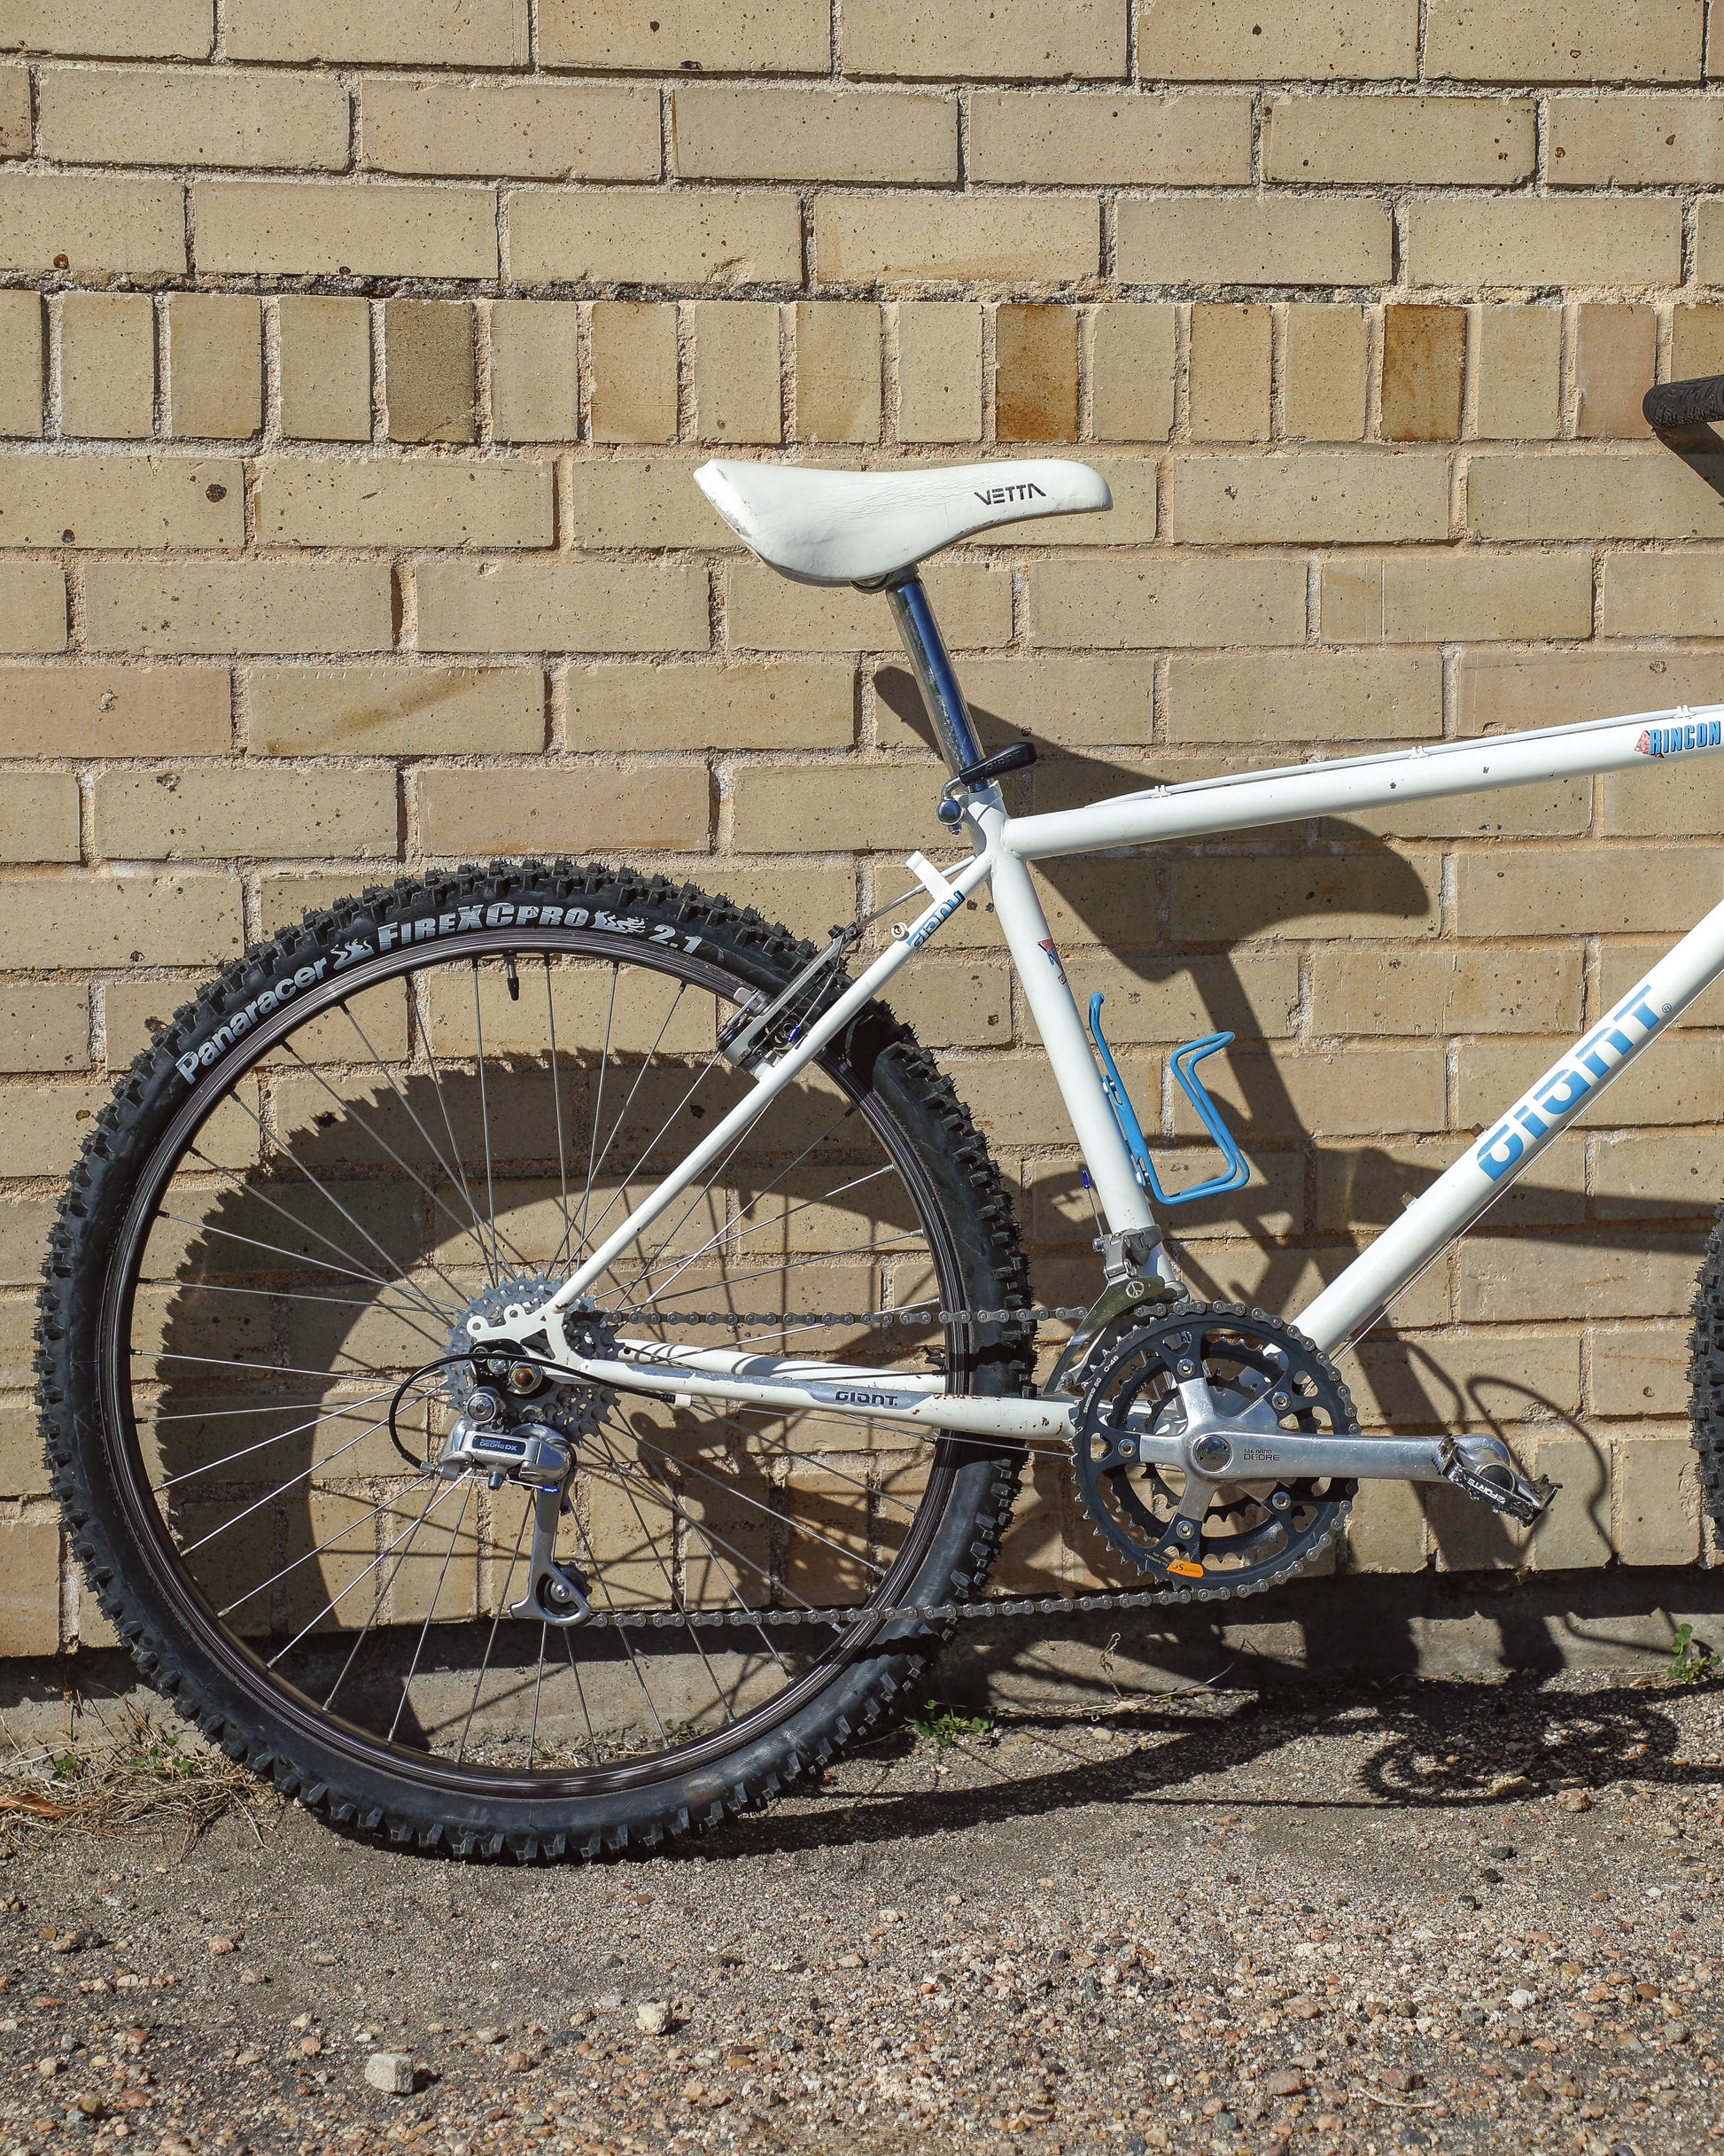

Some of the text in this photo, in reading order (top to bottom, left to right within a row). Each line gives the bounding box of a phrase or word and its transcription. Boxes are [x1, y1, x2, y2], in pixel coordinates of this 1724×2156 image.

[974, 483, 1046, 505] VETTA
[1650, 720, 1720, 756] RINCON
[175, 957, 327, 1085] Panaracer
[648, 923, 703, 954] 2.1
[1467, 1477, 1500, 1499] FORTE
